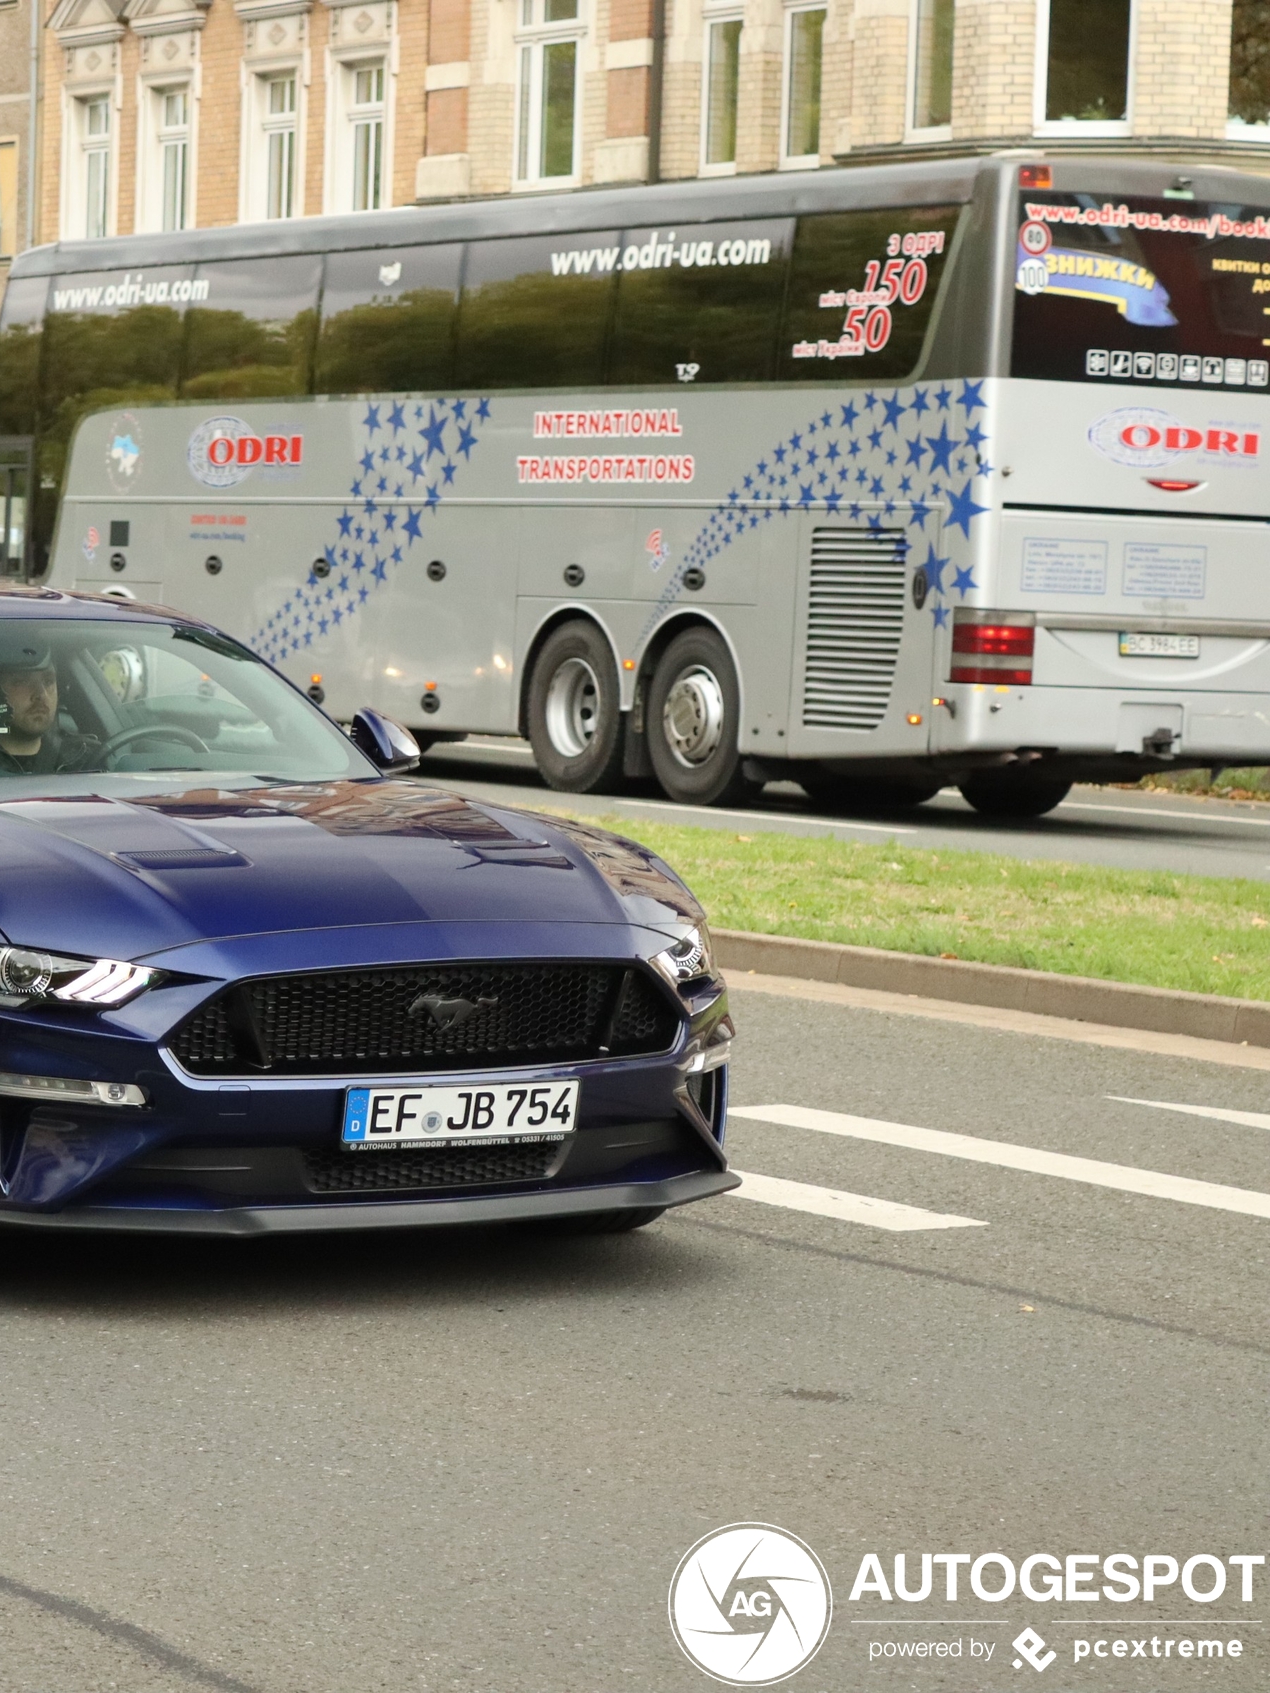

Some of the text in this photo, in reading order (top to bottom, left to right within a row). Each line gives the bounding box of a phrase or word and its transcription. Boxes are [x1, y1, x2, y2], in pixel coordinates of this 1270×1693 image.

[1028, 230, 1042, 243] 80
[551, 231, 771, 275] www.odri-ua.com
[864, 259, 927, 306] 150
[1020, 266, 1045, 288] 100
[1044, 253, 1156, 290] ЗНИЖКИ
[53, 273, 209, 310] www.odri-ua.com
[843, 306, 892, 352] 50
[534, 410, 682, 436] INTERNATIONAL
[208, 435, 304, 466] ODRI
[1121, 424, 1259, 456] ODRI
[517, 455, 695, 483] TRANSPORTATIONS
[351, 1087, 571, 1134] D EF JB 754
[358, 1142, 397, 1150] AUTOHAUS
[400, 1139, 447, 1149] HAMMDORF
[451, 1136, 510, 1147] WOLFENBÜTTEL
